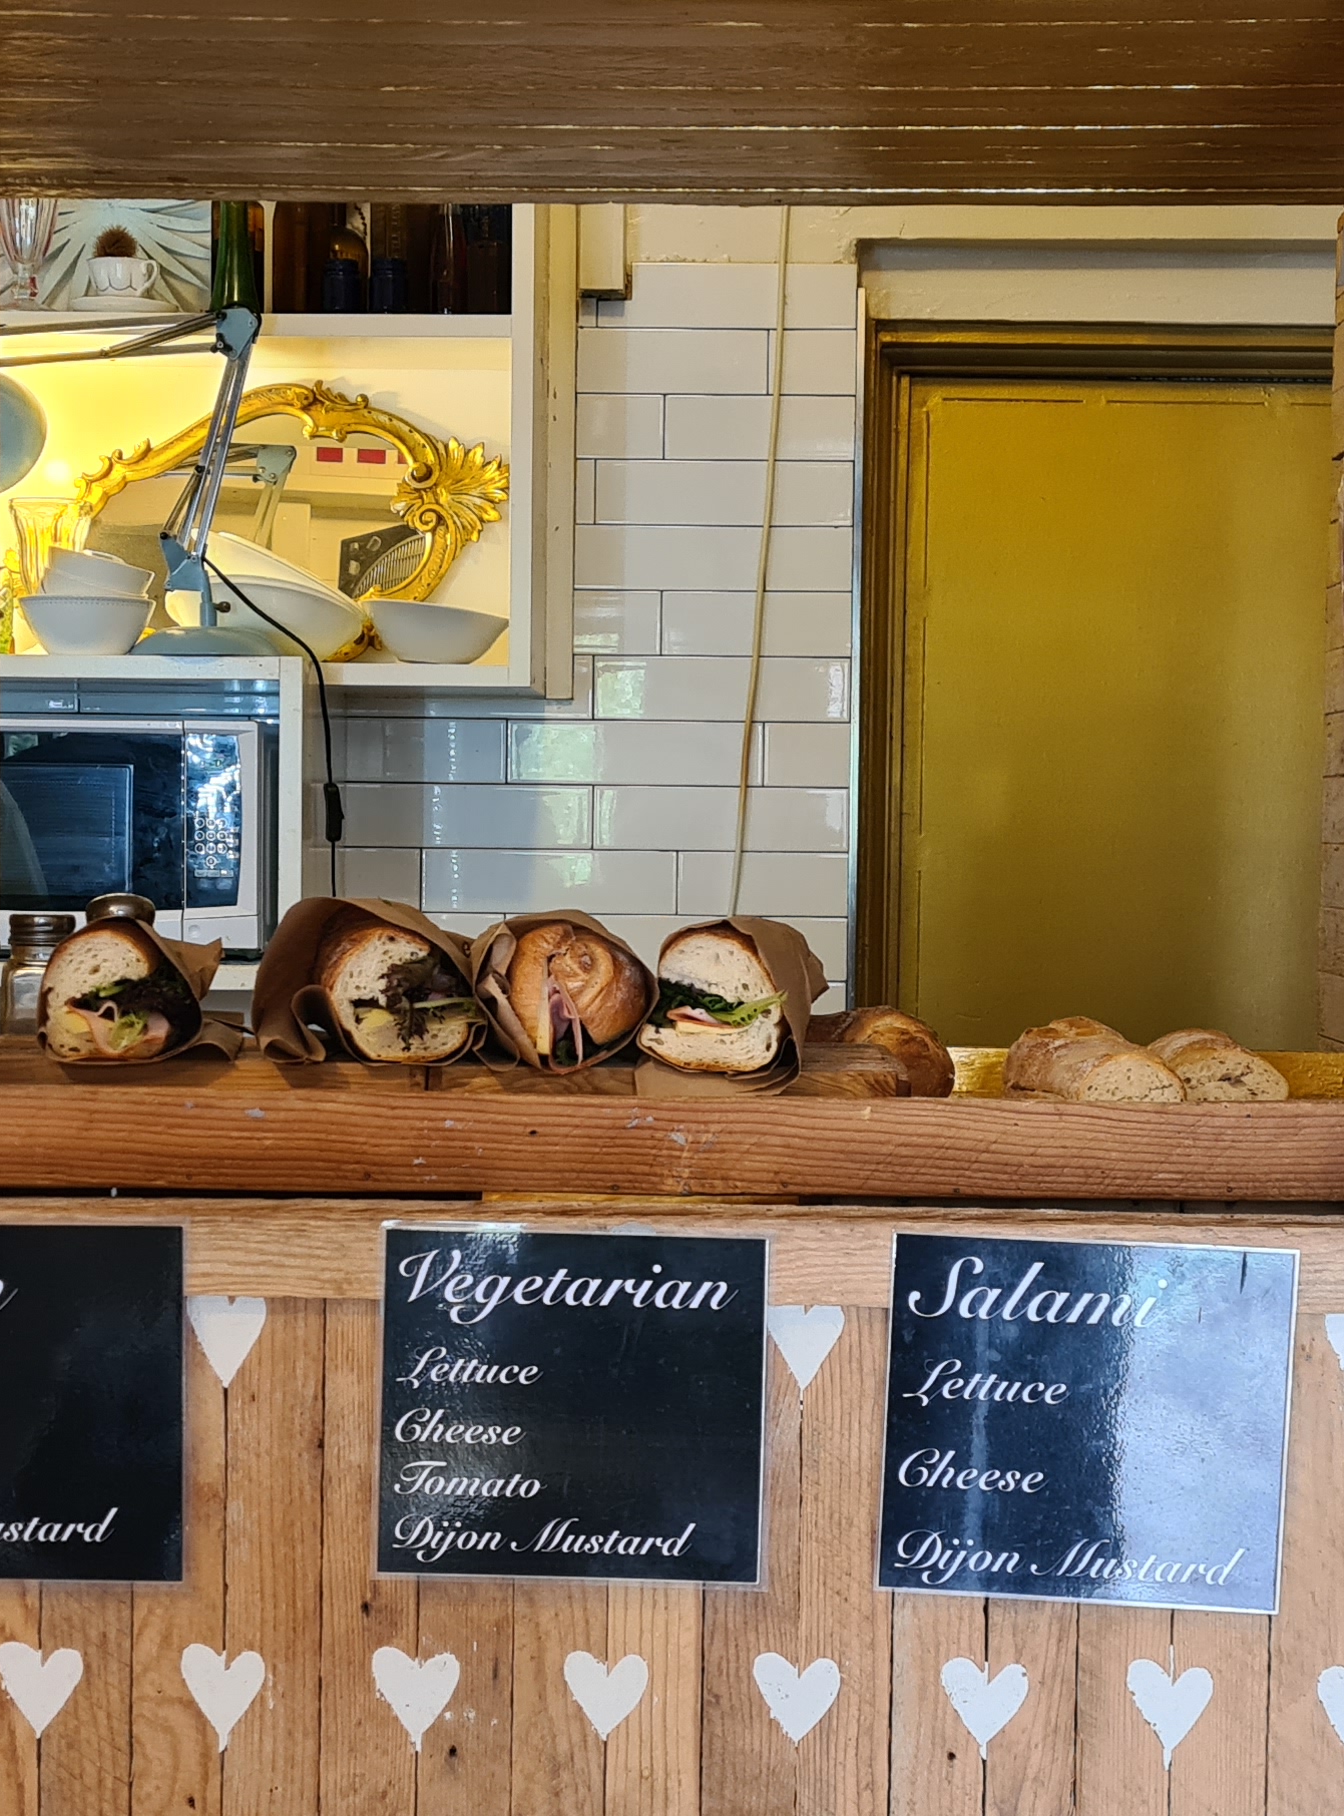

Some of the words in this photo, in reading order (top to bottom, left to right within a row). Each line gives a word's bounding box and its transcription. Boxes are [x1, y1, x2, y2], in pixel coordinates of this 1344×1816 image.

[398, 1249, 740, 1325] Vegetarian
[907, 1255, 1162, 1328] Salami
[396, 1346, 543, 1389] Lettuce
[902, 1358, 1070, 1407] Lettuce
[394, 1407, 526, 1446] Cheese
[393, 1460, 547, 1499] Tomato
[898, 1448, 1050, 1493] Cheese
[392, 1513, 508, 1563] Dijon
[510, 1517, 697, 1557] Mustard
[894, 1528, 1025, 1585] Dijon
[1031, 1537, 1246, 1586] Mustard
